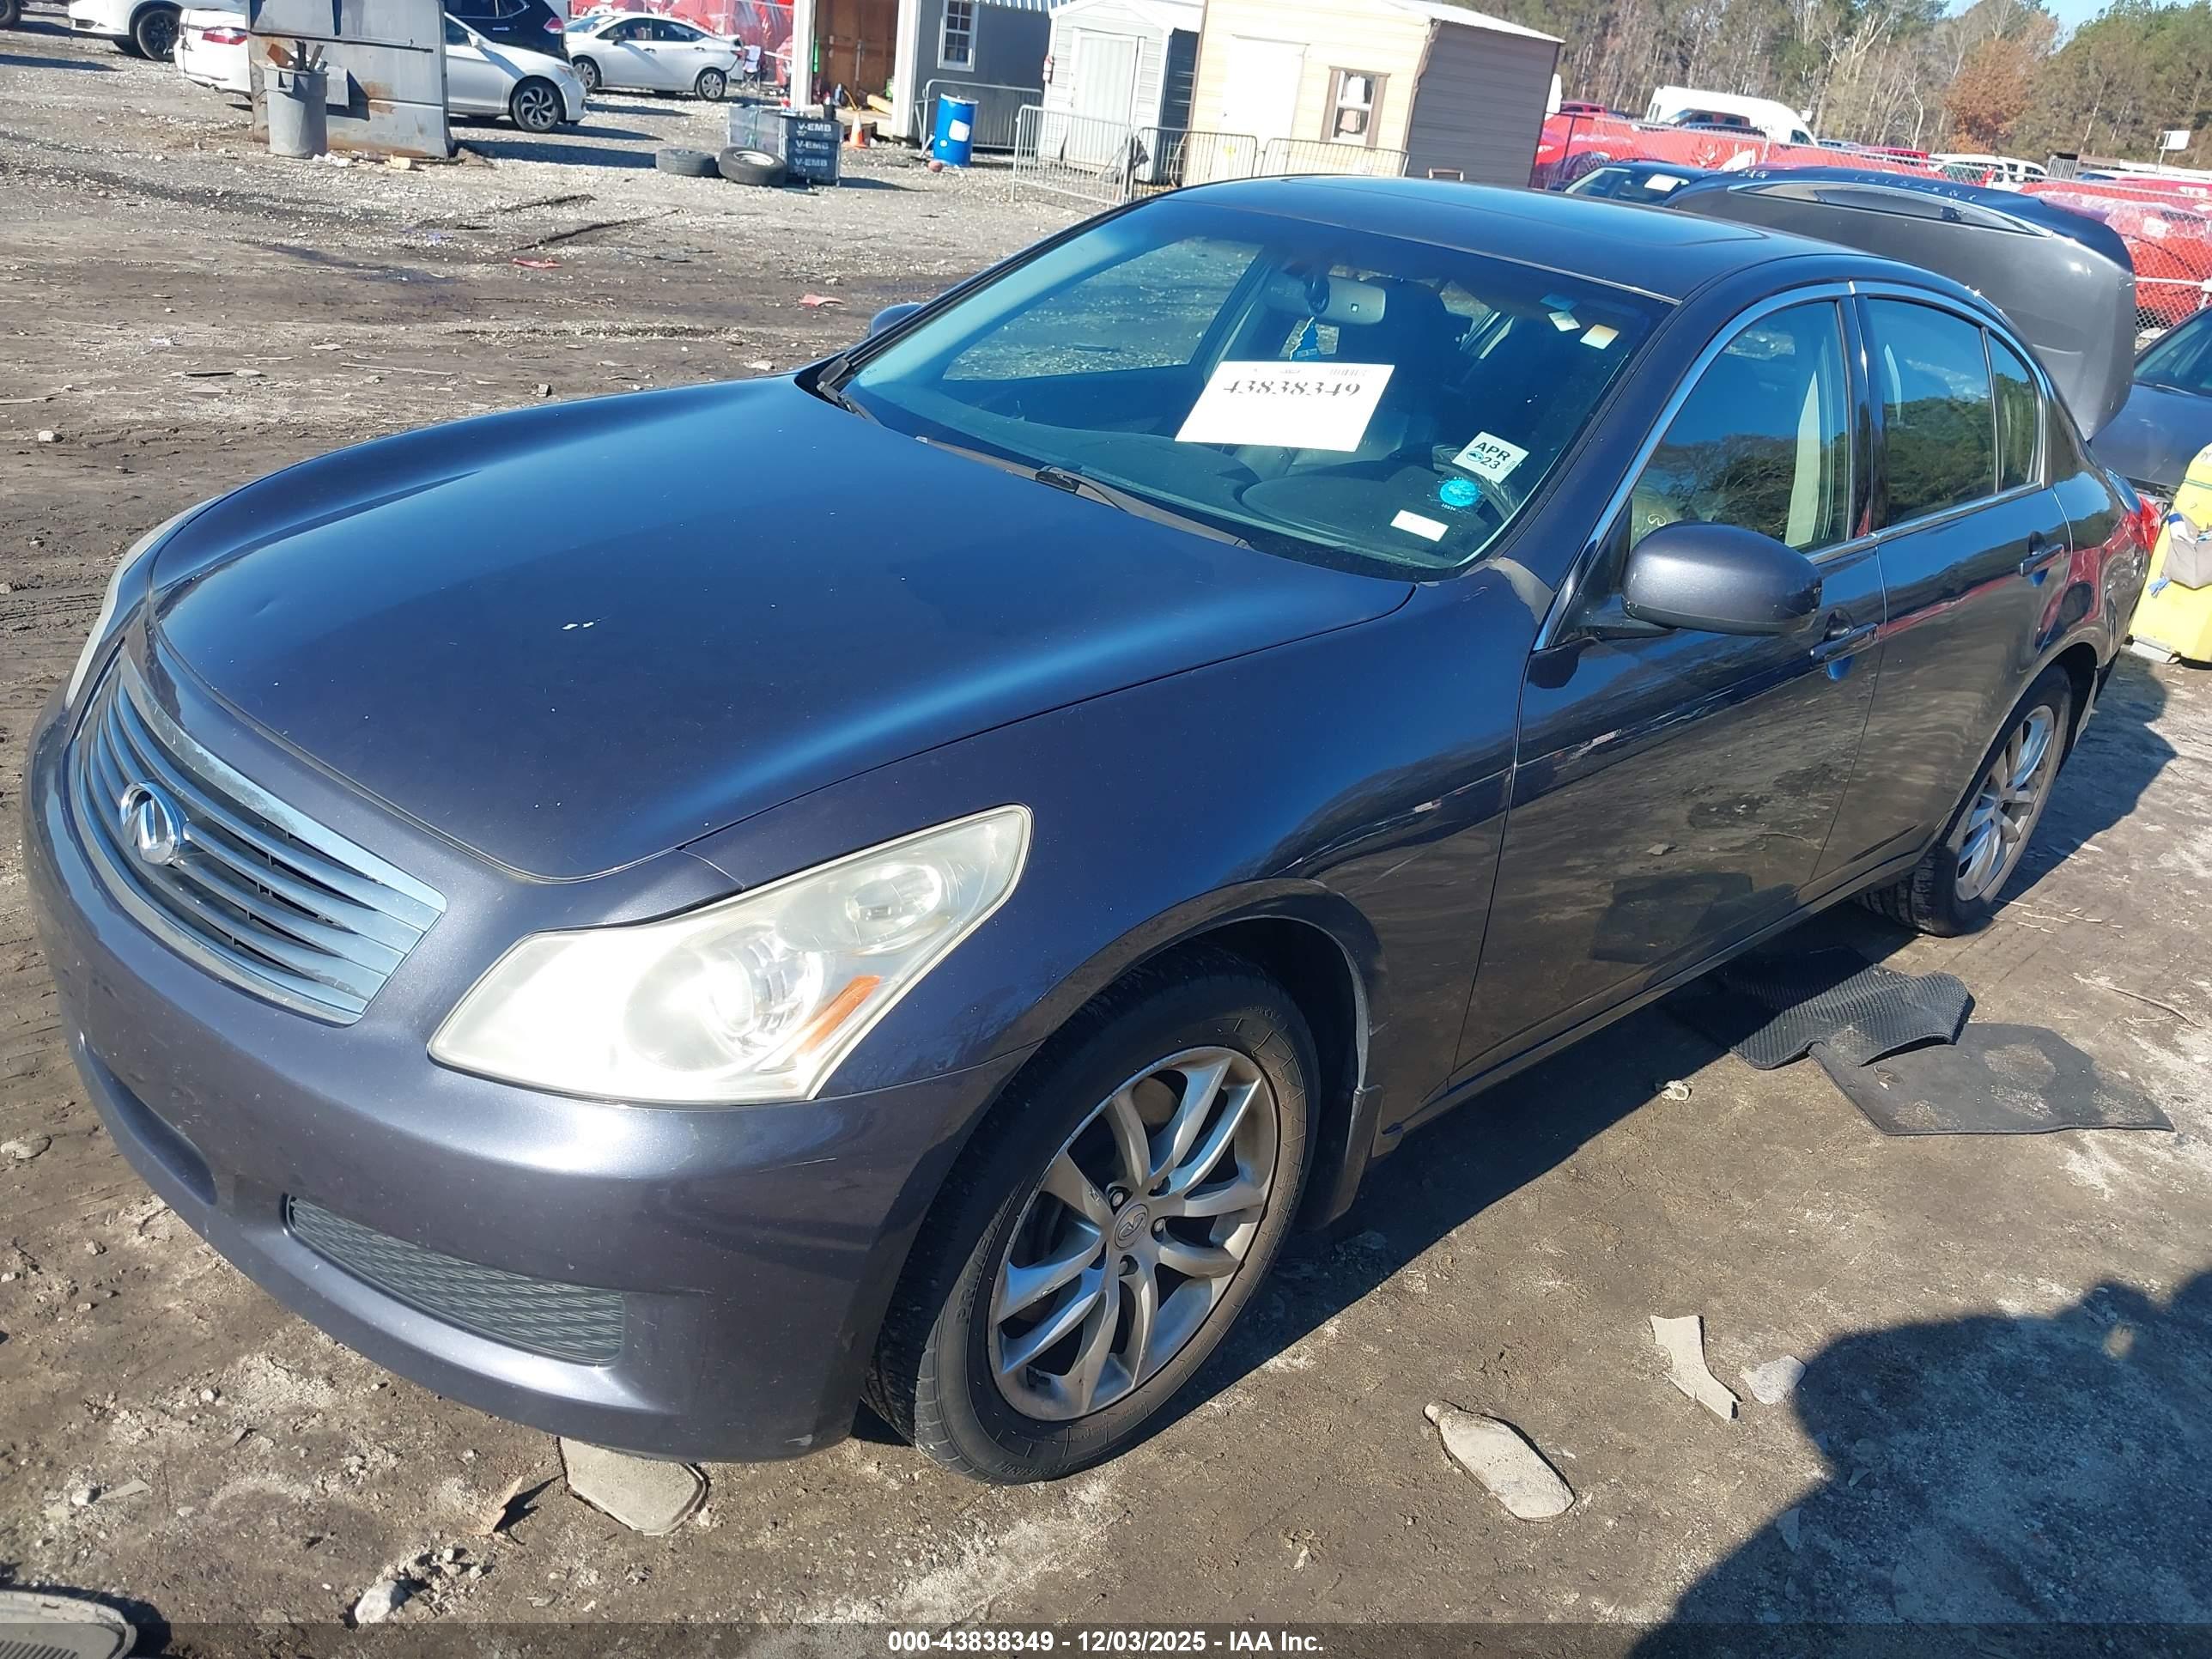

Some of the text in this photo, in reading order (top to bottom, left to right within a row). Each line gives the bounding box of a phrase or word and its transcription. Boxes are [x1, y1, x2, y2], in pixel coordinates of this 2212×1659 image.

[1223, 380, 1361, 397] 43838349
[1474, 441, 1511, 461] APR
[1480, 456, 1501, 470] 23
